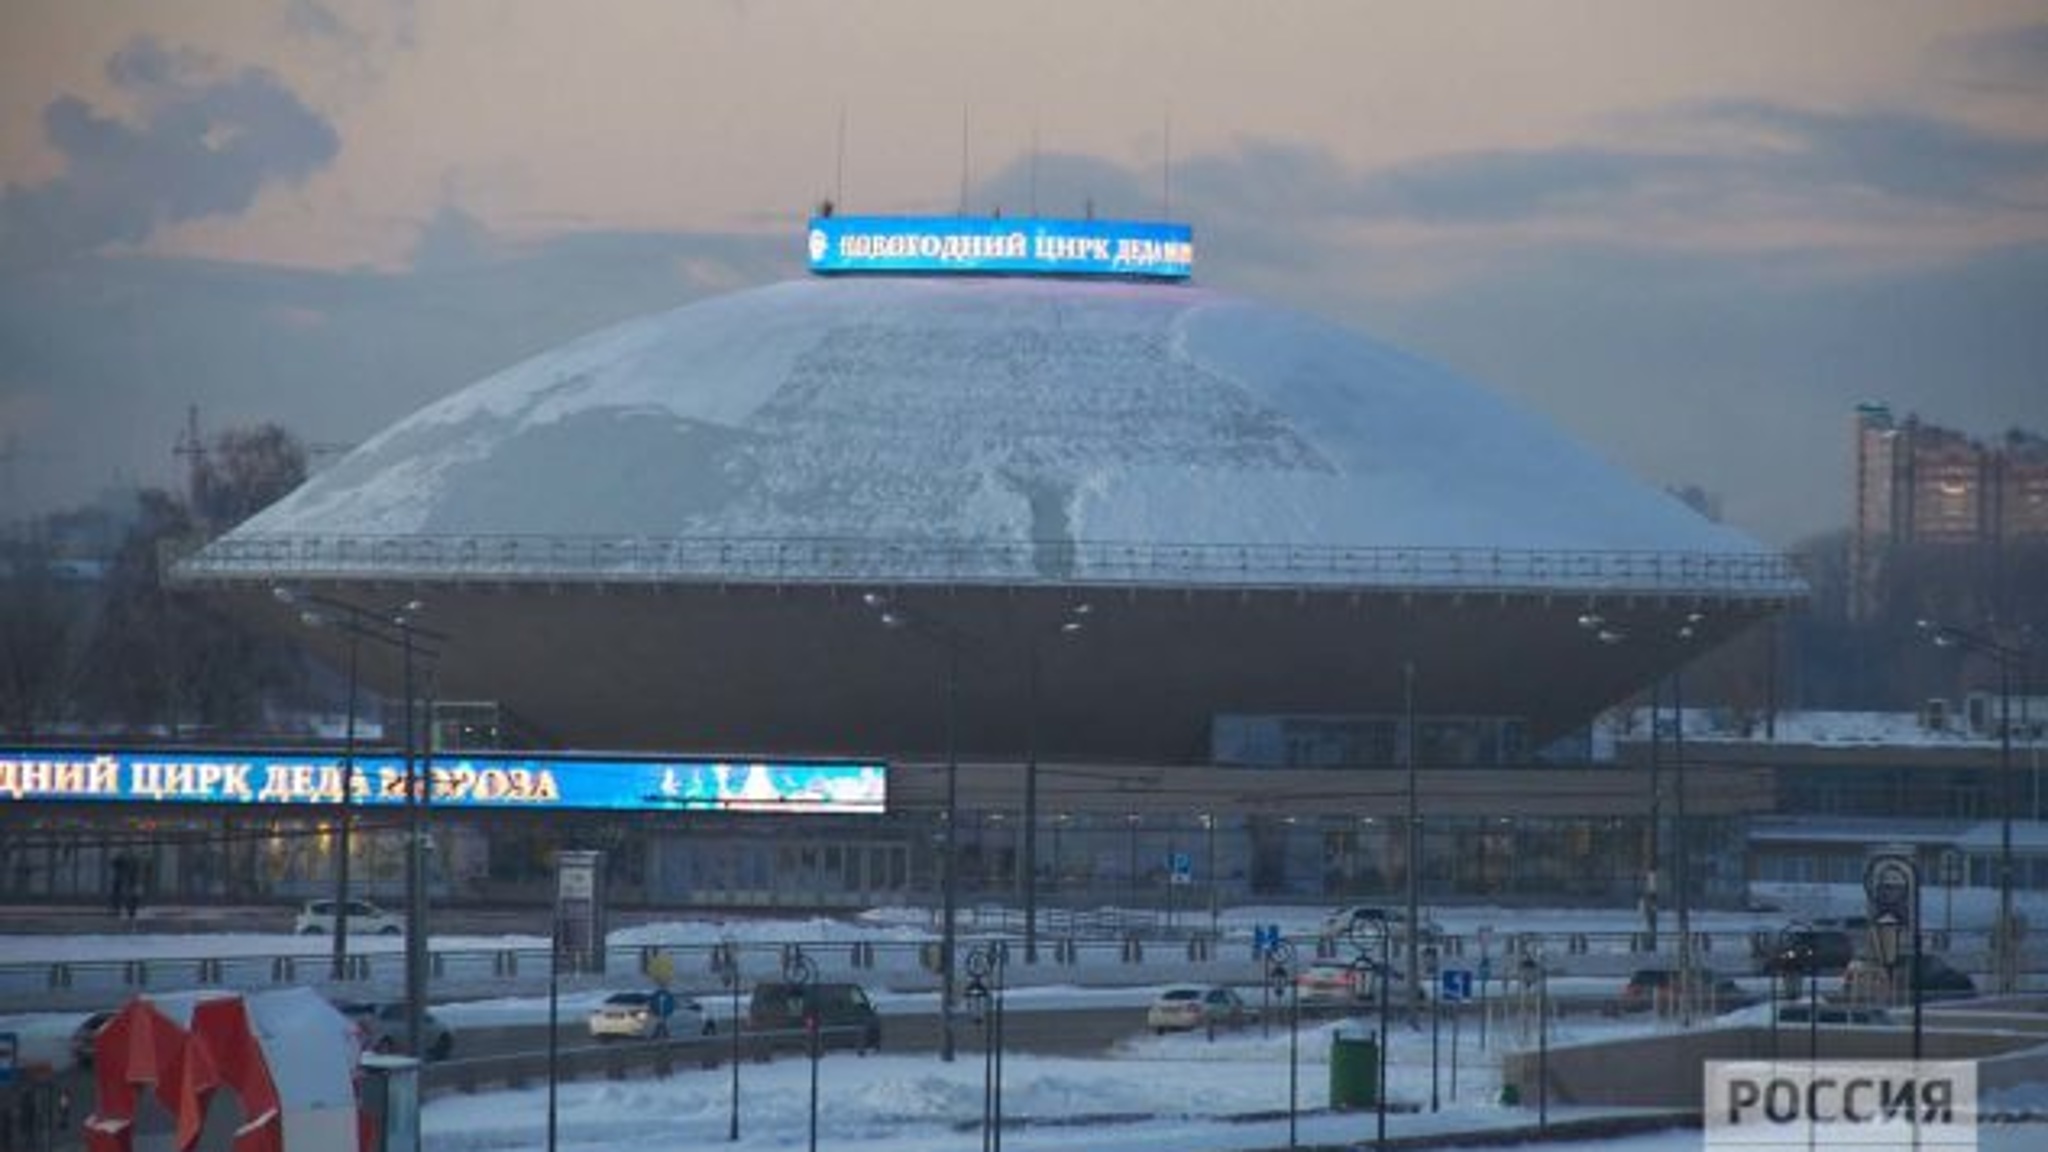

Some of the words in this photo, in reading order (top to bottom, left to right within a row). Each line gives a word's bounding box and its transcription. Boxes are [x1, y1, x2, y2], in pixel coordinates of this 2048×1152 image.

[1035, 235, 1109, 262] ЦИРК
[132, 762, 252, 801] ЦИРК
[259, 764, 371, 803] ДЕДА
